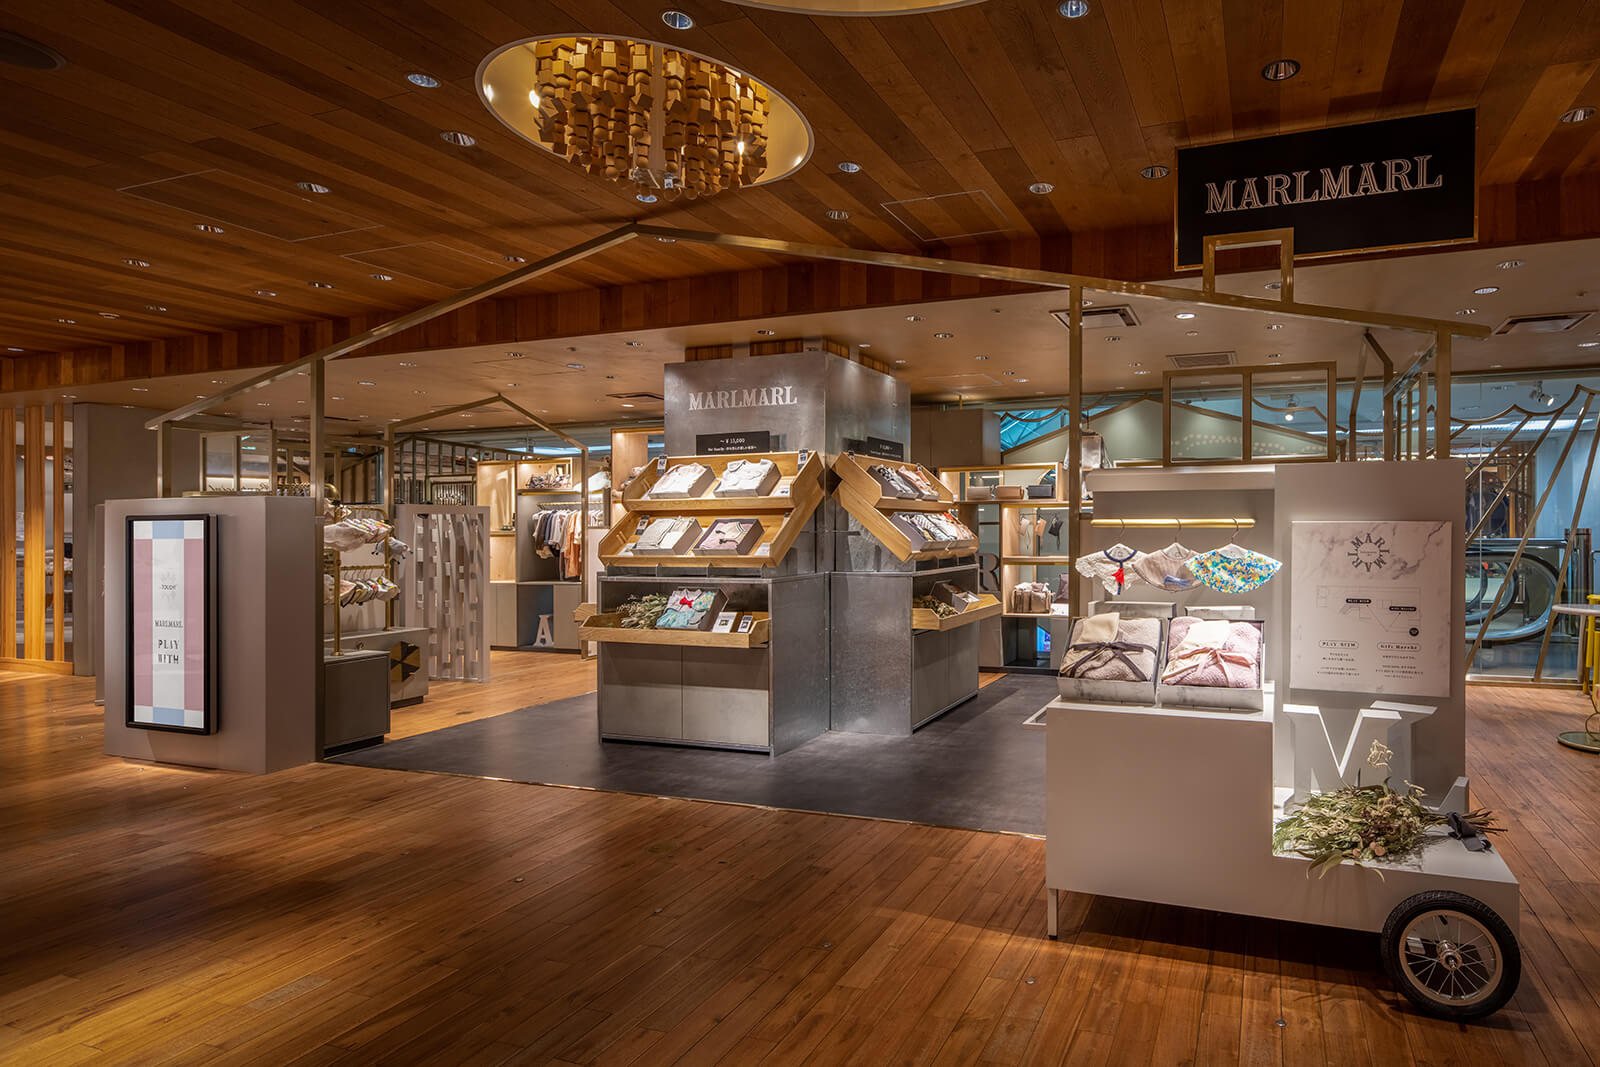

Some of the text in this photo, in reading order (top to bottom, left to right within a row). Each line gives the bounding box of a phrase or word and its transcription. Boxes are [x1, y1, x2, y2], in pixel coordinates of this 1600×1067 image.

[1205, 155, 1443, 214] MARLMARL
[688, 385, 798, 411] MARLMARL
[158, 640, 179, 650] PLAY
[533, 614, 554, 647] A
